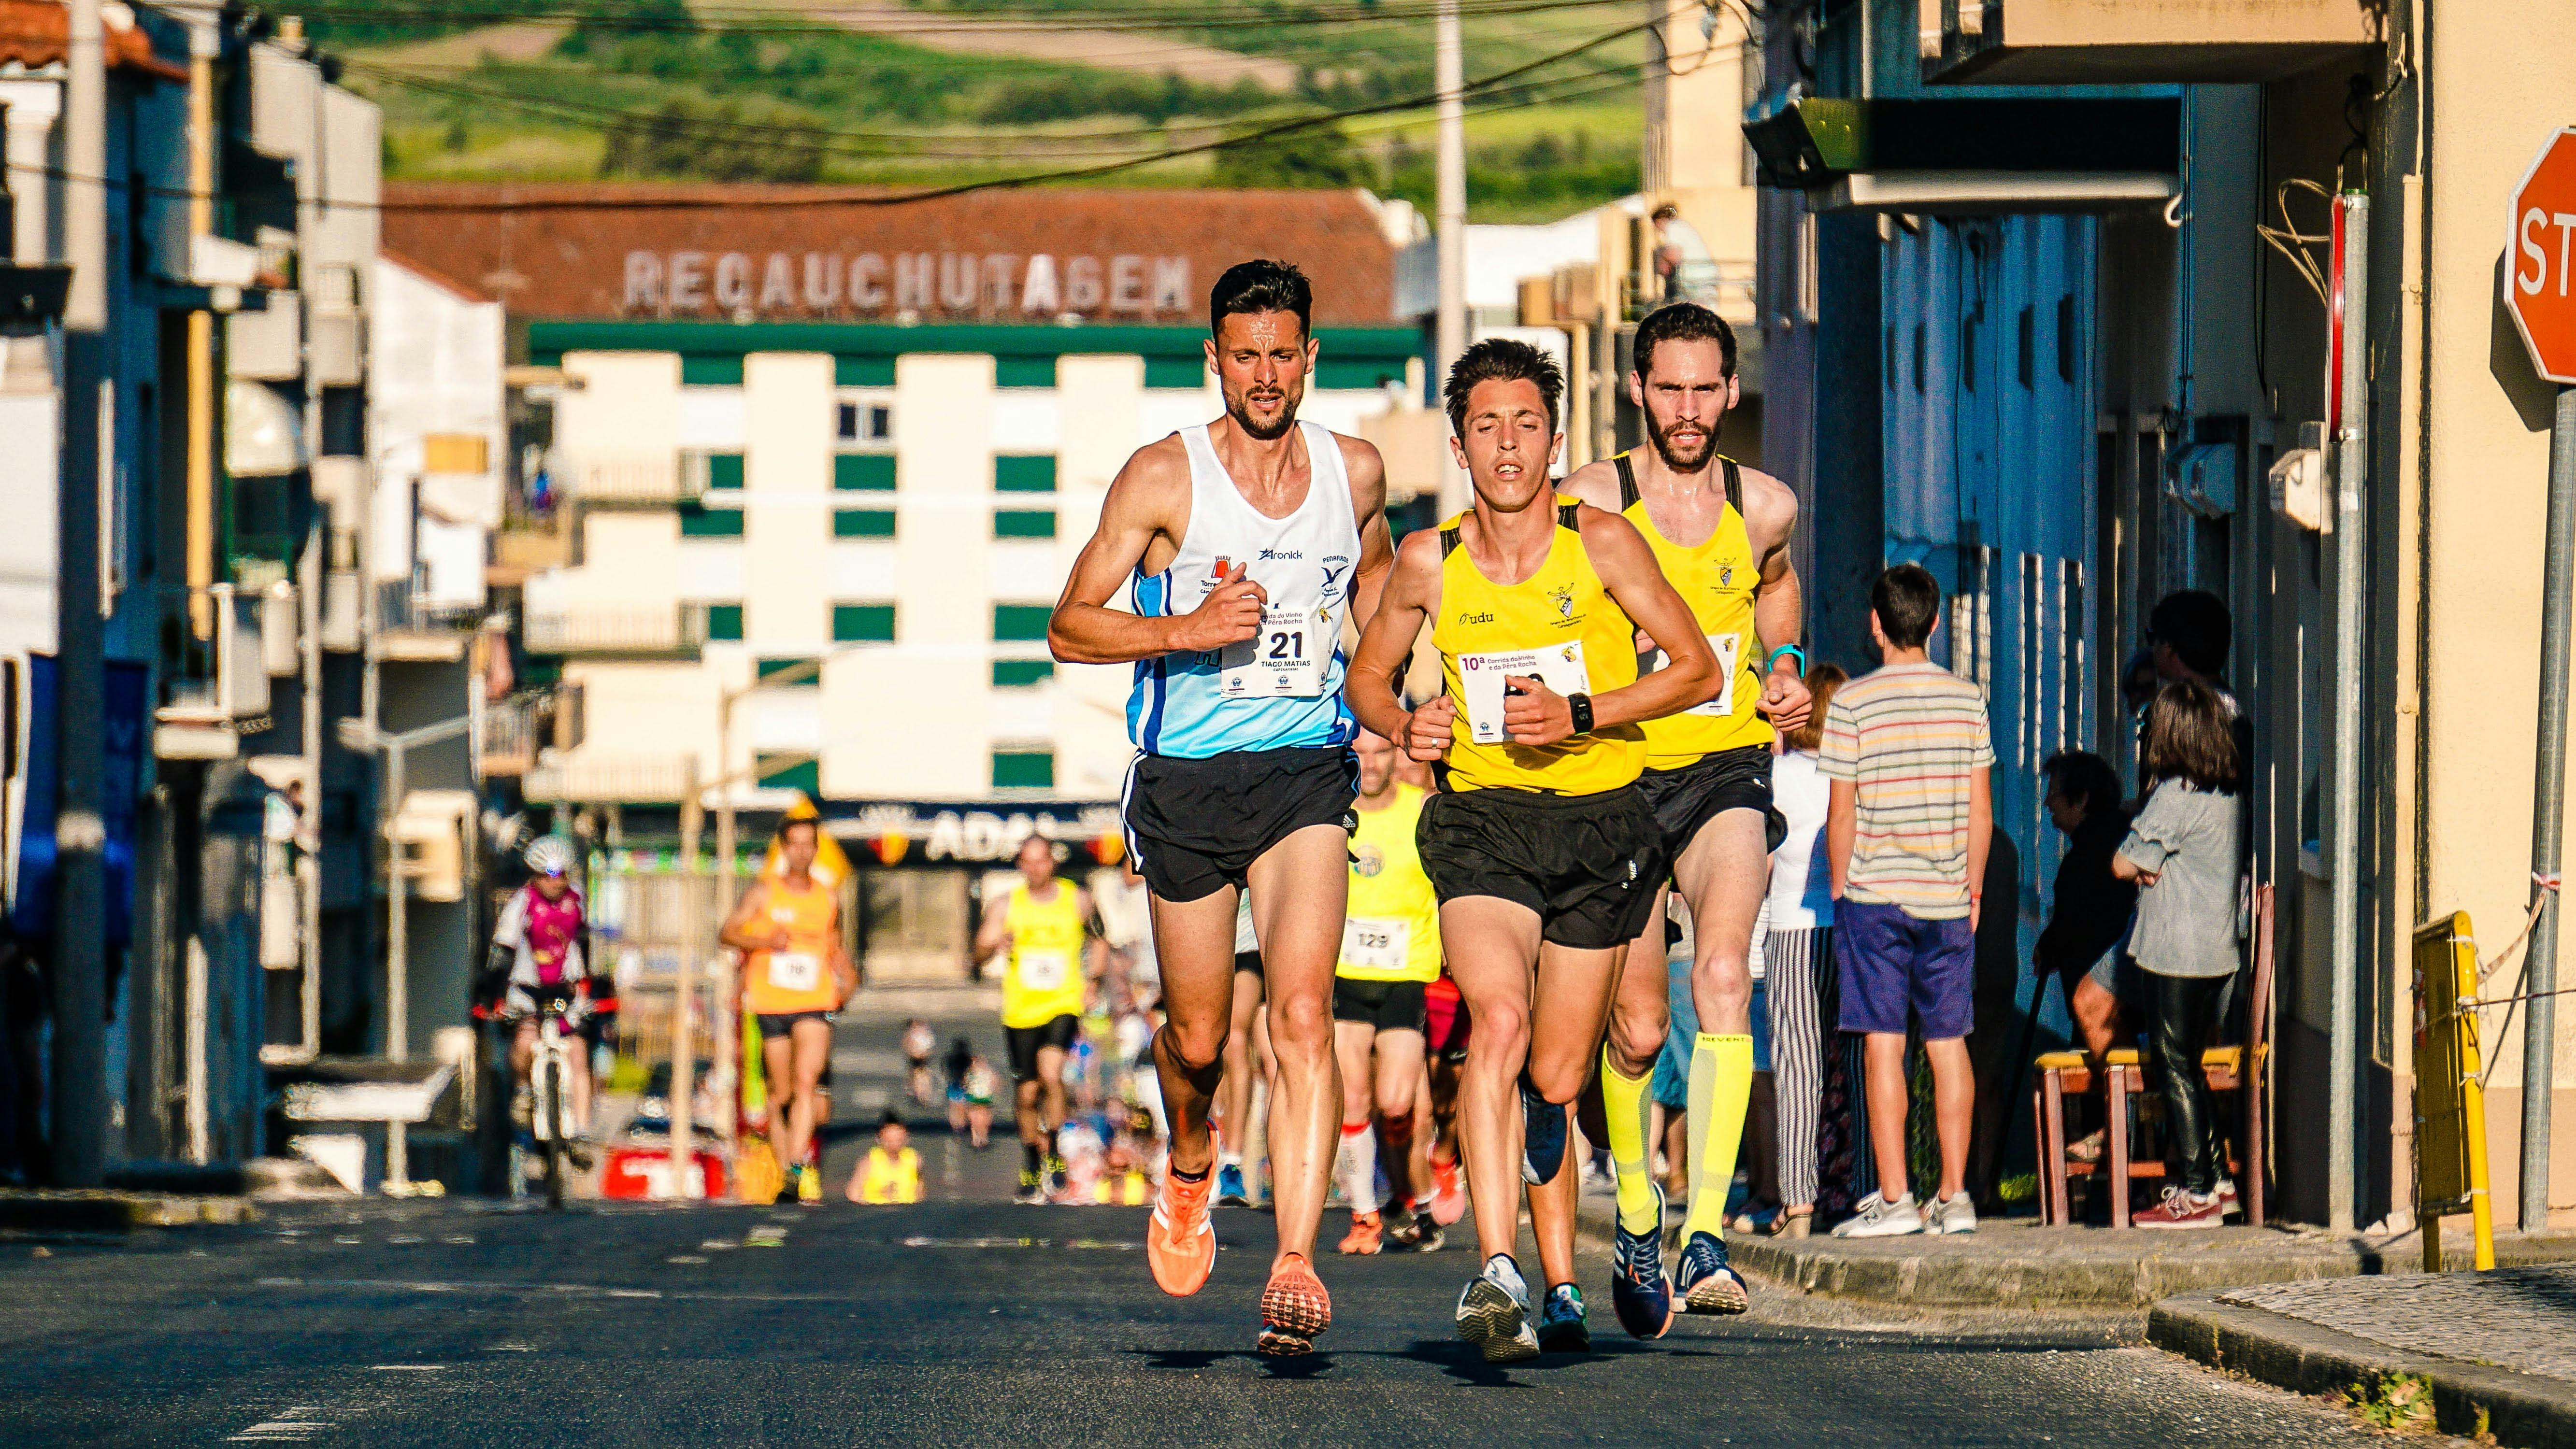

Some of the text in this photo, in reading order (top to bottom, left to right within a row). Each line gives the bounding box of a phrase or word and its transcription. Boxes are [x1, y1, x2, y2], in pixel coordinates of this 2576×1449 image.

[2518, 206, 2576, 297] ST
[1323, 555, 1349, 563] PENAFIRME
[1269, 632, 1302, 659] 21
[1358, 933, 1390, 948] 129
